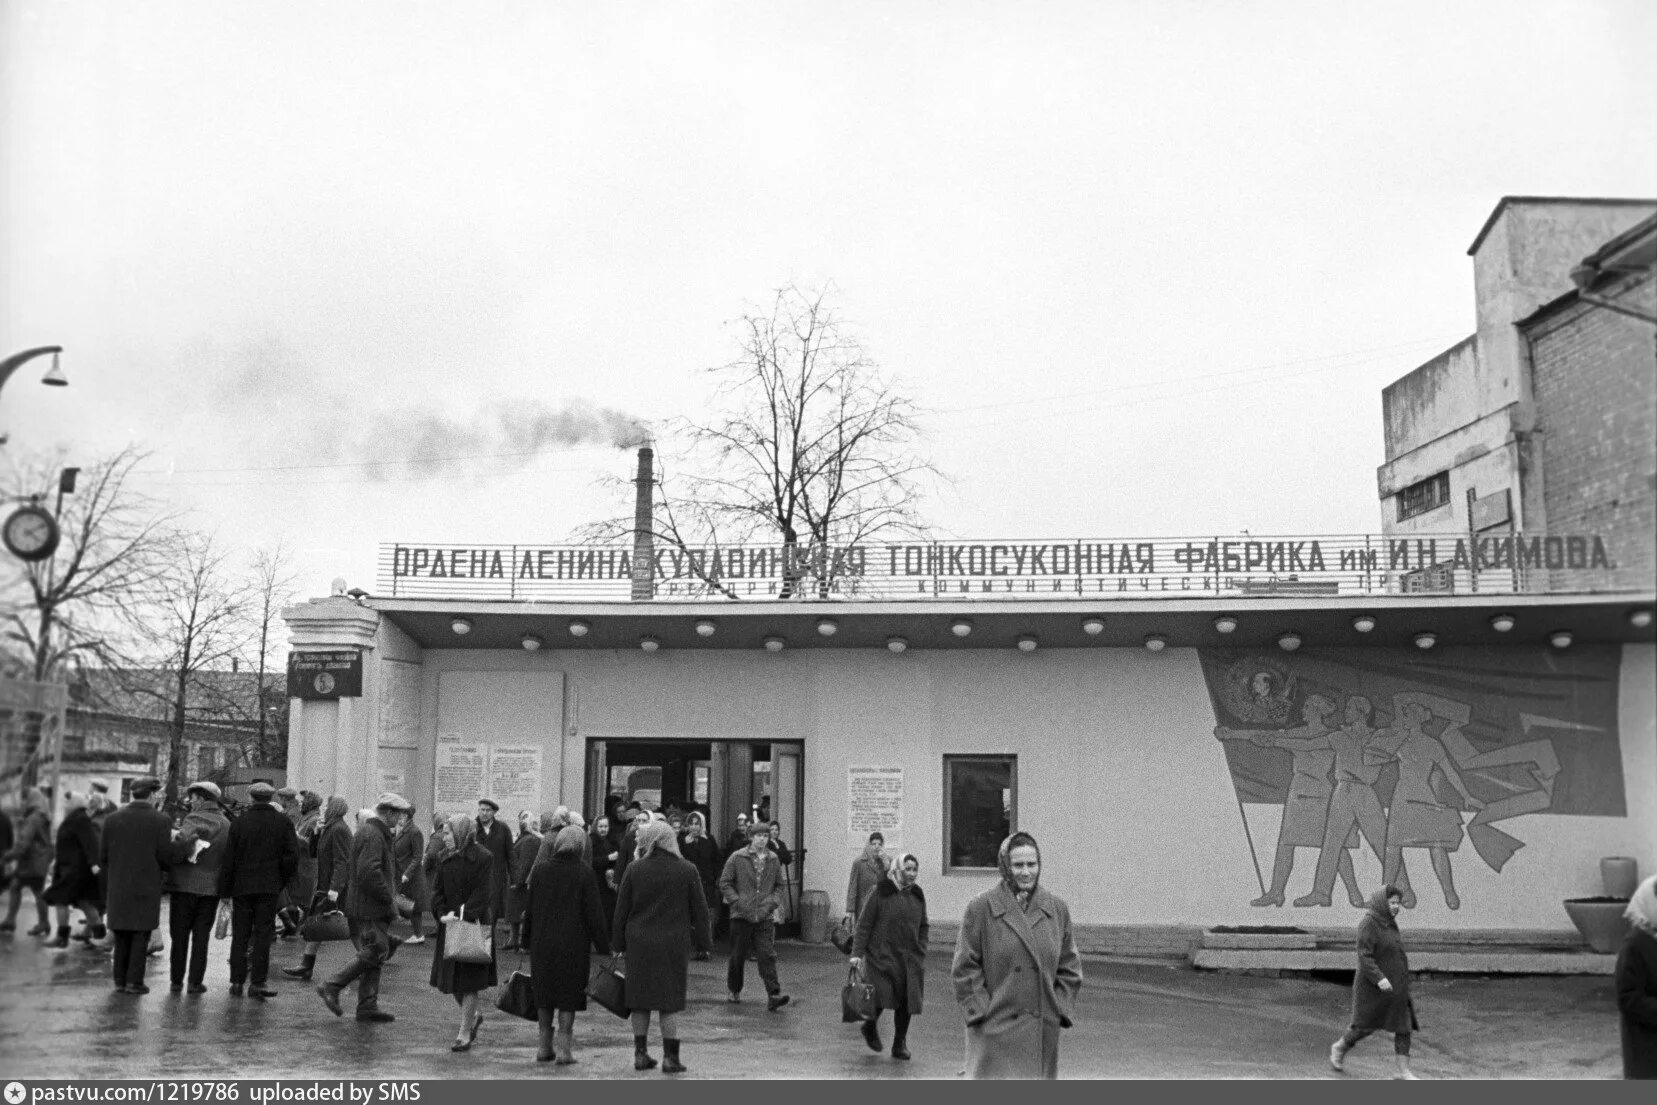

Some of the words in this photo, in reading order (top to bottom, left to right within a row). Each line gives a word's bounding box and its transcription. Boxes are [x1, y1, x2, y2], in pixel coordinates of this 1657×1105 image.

[394, 547, 504, 578] ОРДЕНА
[519, 549, 634, 579] ЛЕНИНА
[885, 543, 1154, 575] ТОНКОСУКОННАЯ
[1174, 541, 1326, 572] ФАБРИКА
